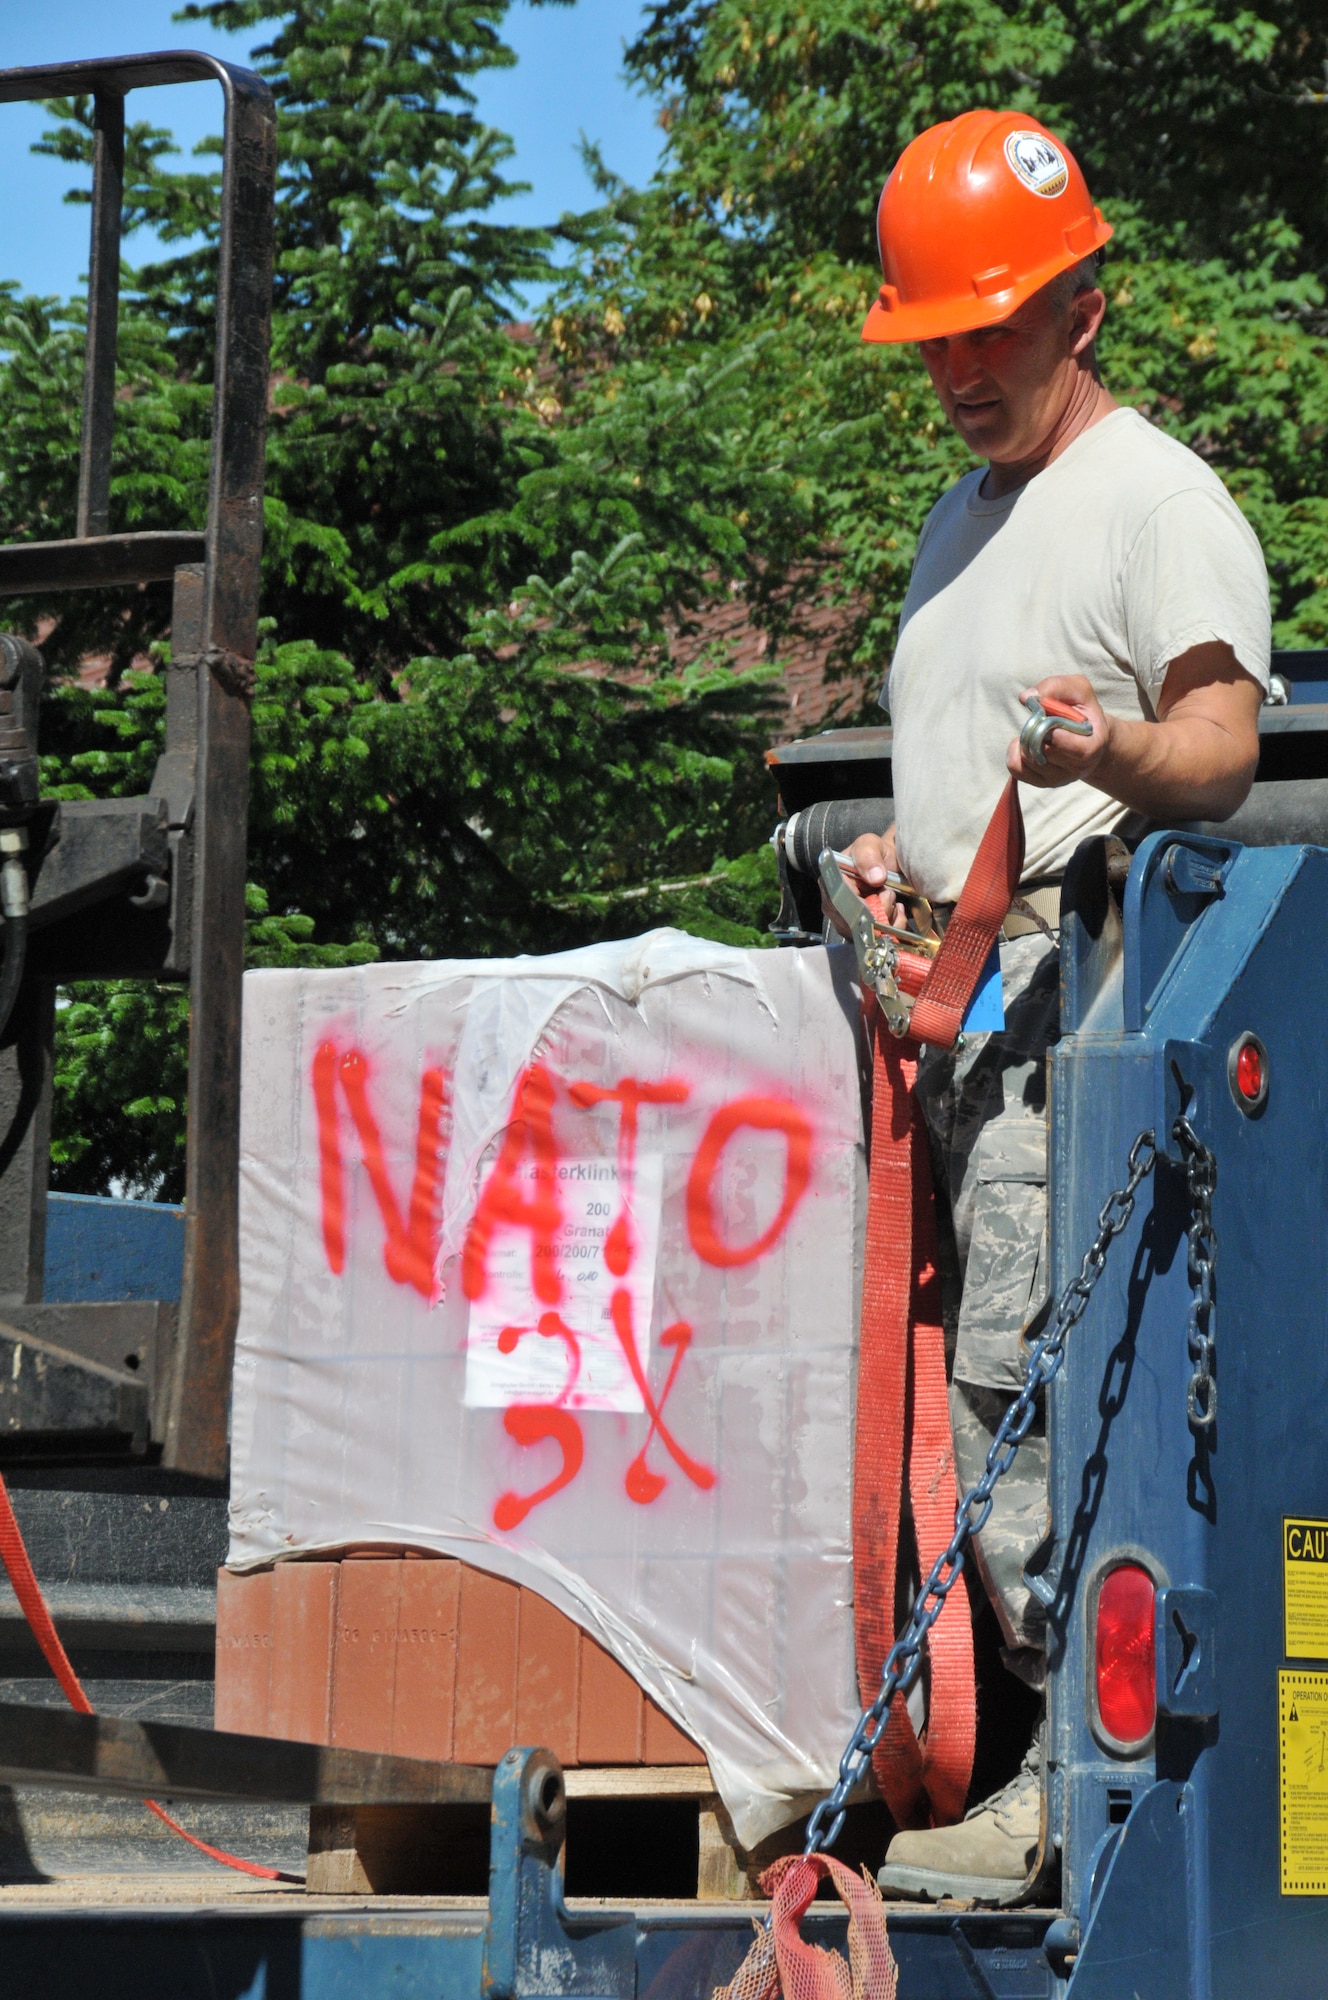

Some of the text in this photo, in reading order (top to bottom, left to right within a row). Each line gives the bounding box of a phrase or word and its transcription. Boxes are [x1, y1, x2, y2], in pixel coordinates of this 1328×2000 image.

[312, 1040, 816, 1309] NATO
[586, 1202, 611, 1216] 200
[1292, 1690, 1323, 1702] OPERATION
